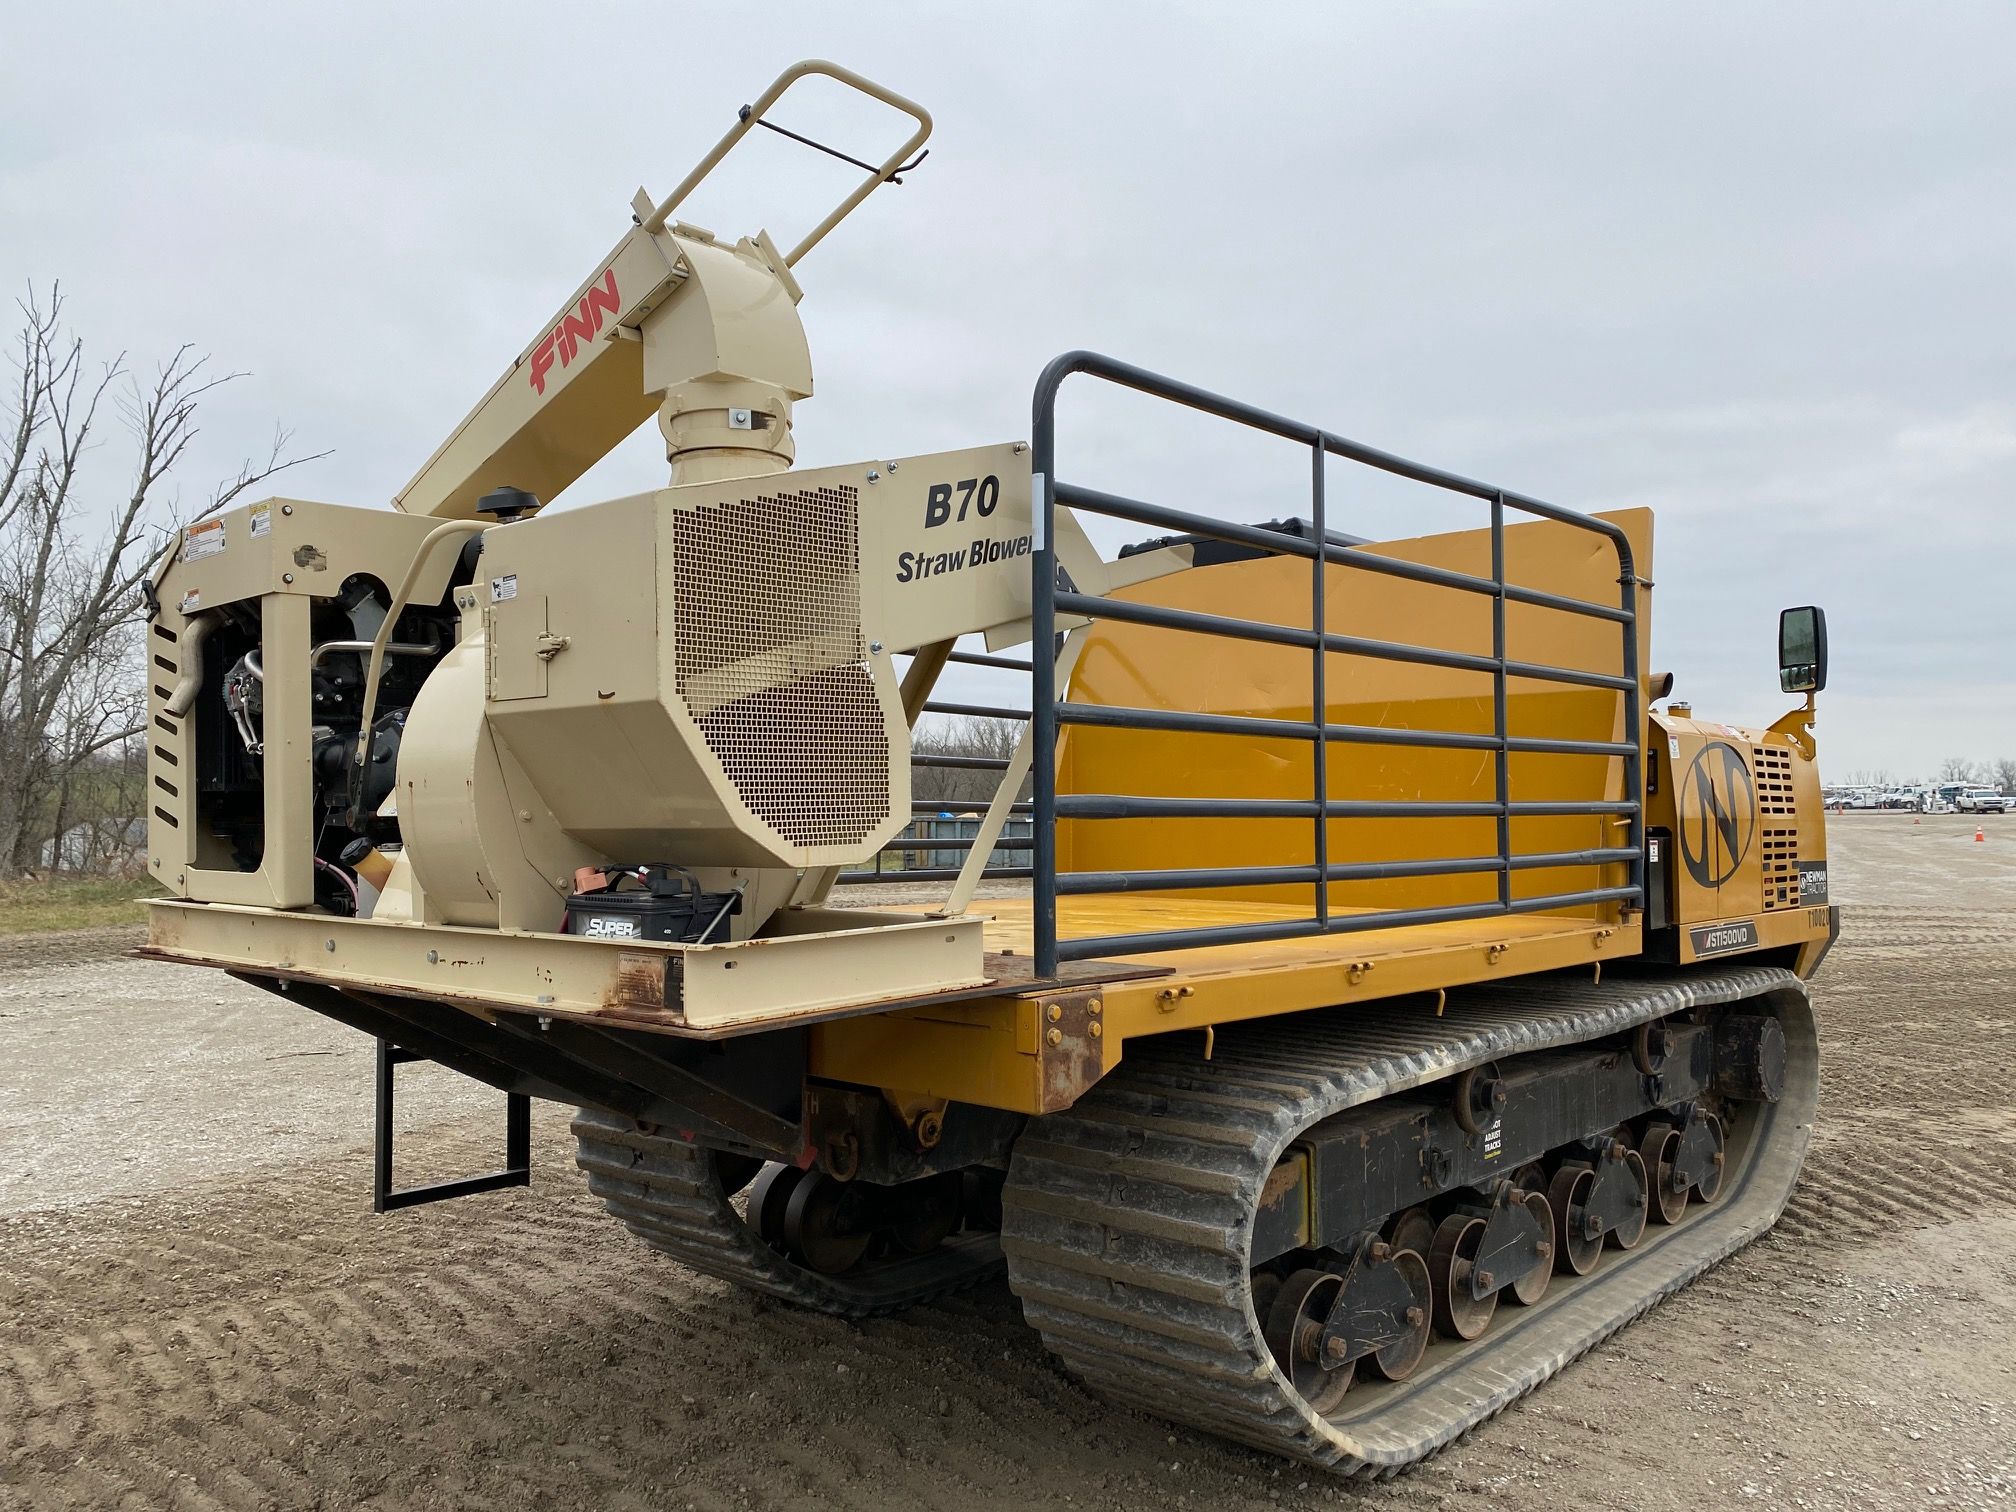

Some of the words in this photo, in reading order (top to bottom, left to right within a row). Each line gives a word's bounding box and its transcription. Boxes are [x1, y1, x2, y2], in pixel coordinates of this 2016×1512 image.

[924, 474, 1001, 529] B70
[896, 550, 967, 583] Straw
[1806, 870, 1827, 883] NEWMAN
[1807, 882, 1827, 895] TRACTOR
[590, 918, 634, 936] SUPER
[1485, 1130, 1501, 1142] ADJUST
[1485, 1140, 1501, 1152] TRACKS
